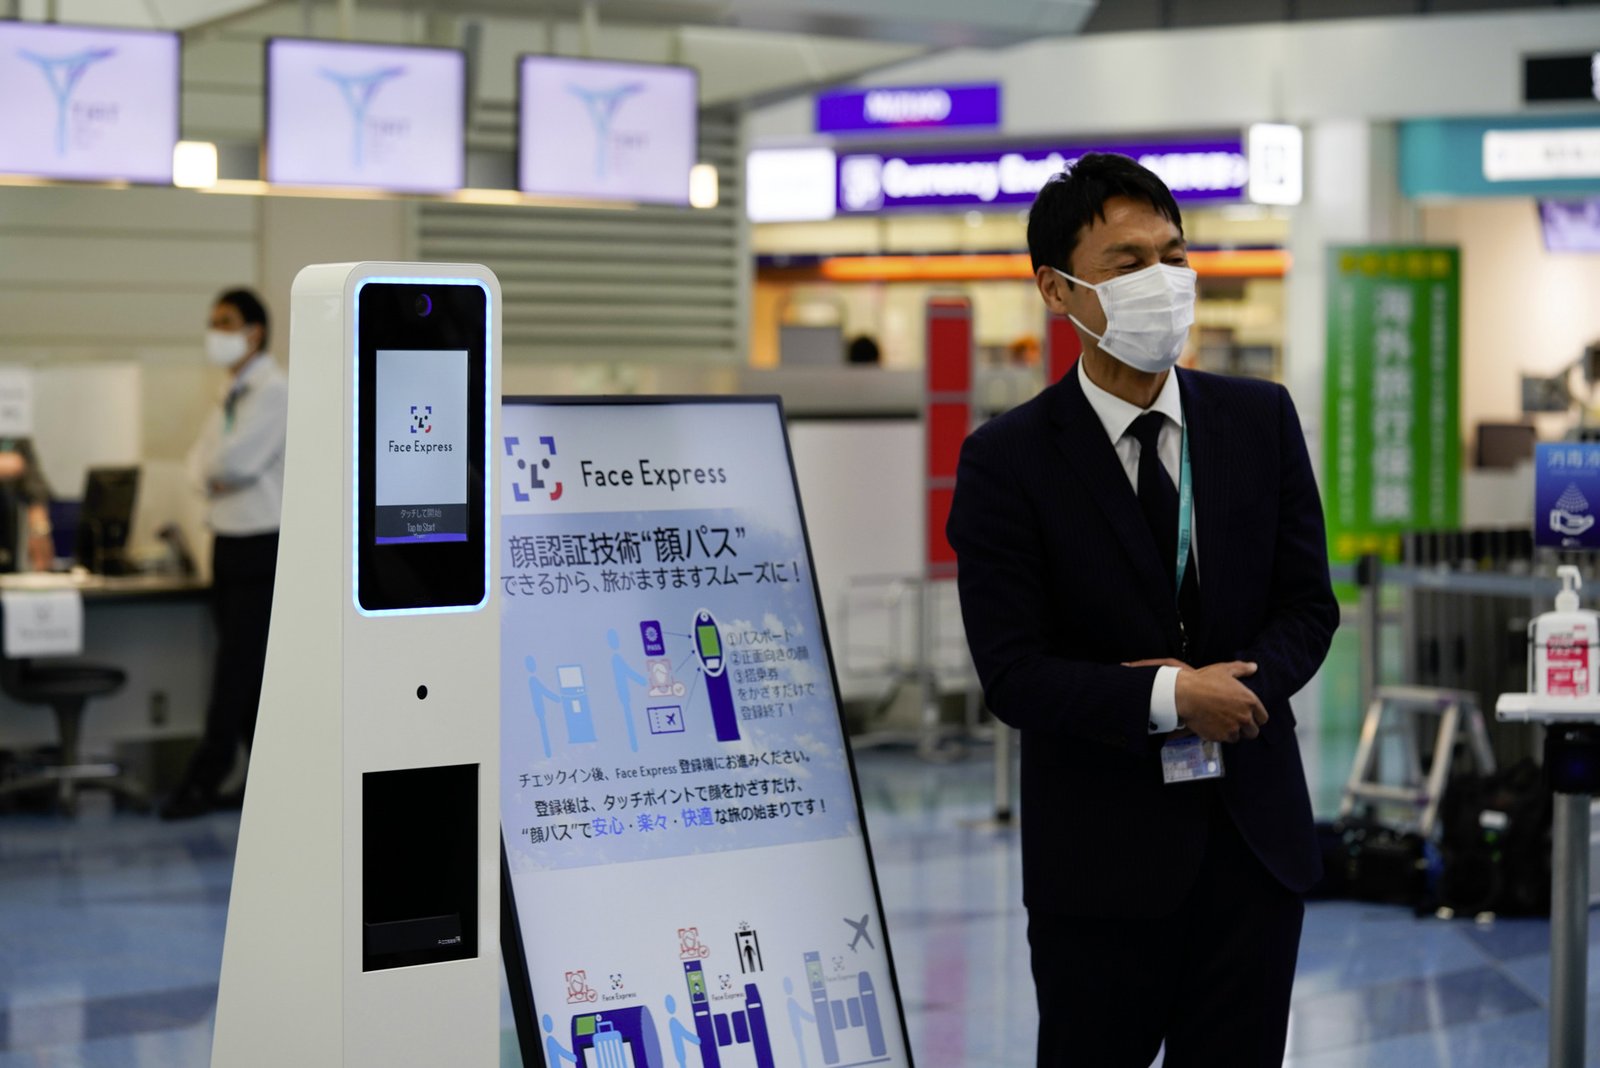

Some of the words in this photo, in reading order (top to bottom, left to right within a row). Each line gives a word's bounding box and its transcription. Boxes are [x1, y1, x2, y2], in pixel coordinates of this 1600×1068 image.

[388, 440, 411, 453] Face
[414, 440, 453, 454] Express
[580, 460, 634, 488] Face
[638, 459, 727, 491] Express
[400, 508, 442, 519] タッチして開始
[407, 523, 417, 533] Tap
[422, 522, 436, 532] Start
[616, 768, 638, 780] Face
[640, 765, 678, 781] Express
